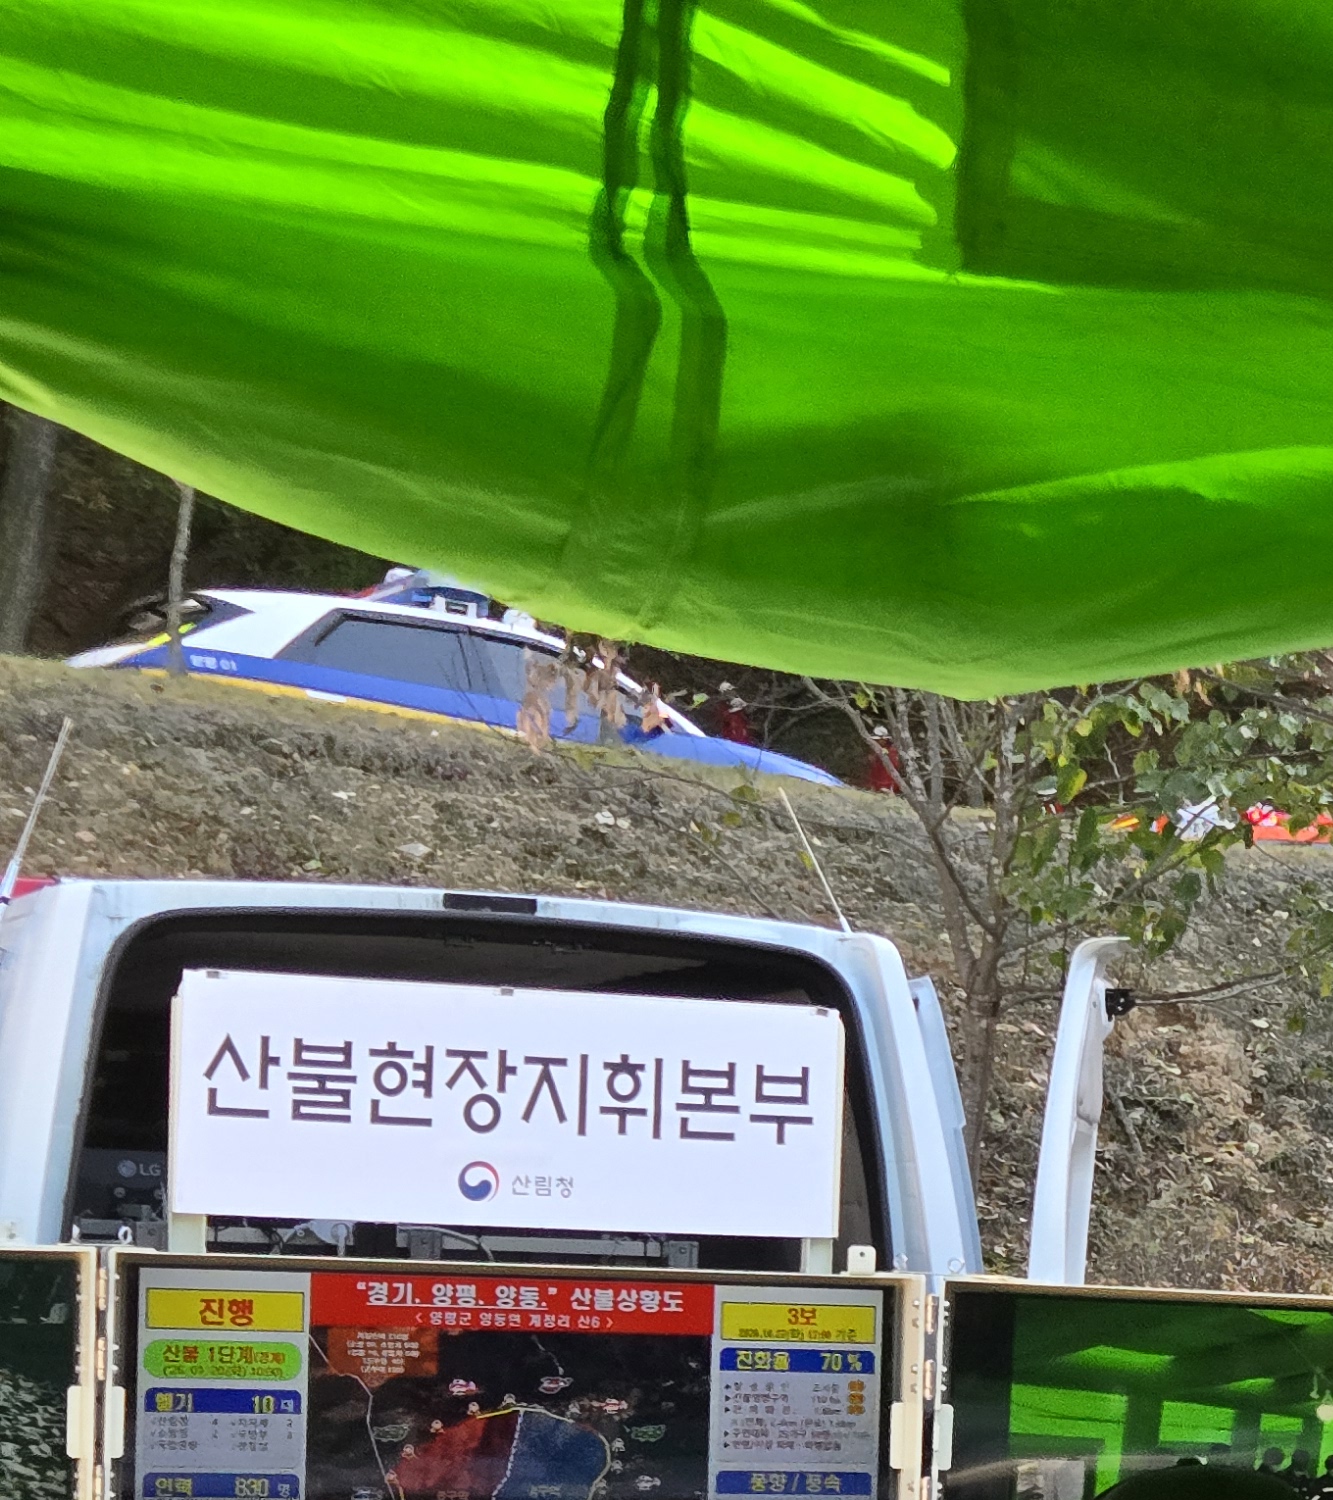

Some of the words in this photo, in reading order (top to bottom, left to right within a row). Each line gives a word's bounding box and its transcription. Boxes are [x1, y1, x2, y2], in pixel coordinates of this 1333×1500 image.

[203, 1033, 814, 1145] 산불현장지휘본부
[140, 1163, 161, 1176] LG
[511, 1174, 575, 1199] 산림청
[570, 1287, 685, 1313] 산불상황도
[199, 1298, 254, 1326] 진행
[430, 1312, 472, 1327] 양평군
[787, 1307, 817, 1326] 3보
[163, 1344, 199, 1364] 산불
[736, 1350, 790, 1371] 진화율
[820, 1352, 842, 1371] 70
[847, 1353, 862, 1371] %
[155, 1392, 194, 1413] 헬기
[252, 1395, 274, 1414] 10
[155, 1477, 193, 1497] 인력
